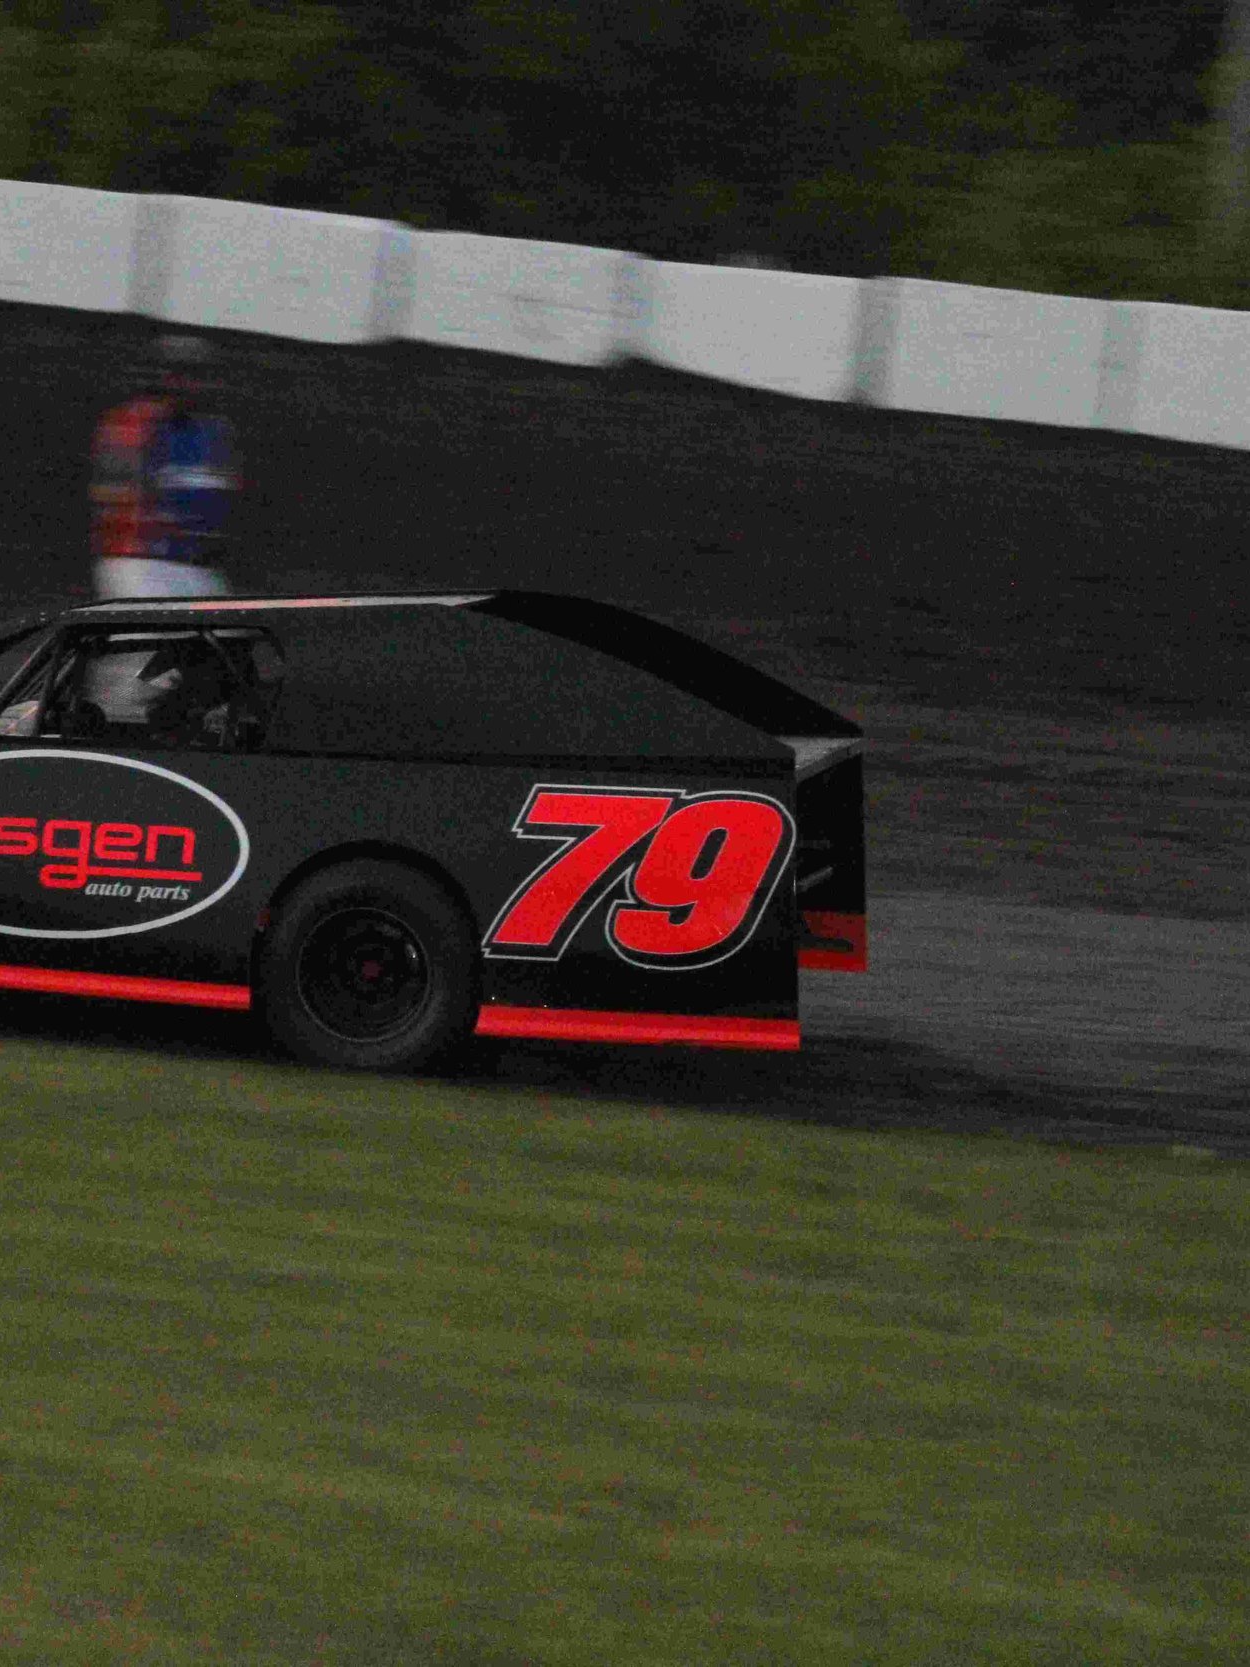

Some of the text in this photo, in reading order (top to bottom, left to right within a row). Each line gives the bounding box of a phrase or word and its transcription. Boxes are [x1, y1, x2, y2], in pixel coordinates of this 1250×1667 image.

[84, 881, 191, 903] auto parts
[485, 785, 794, 968] 79
